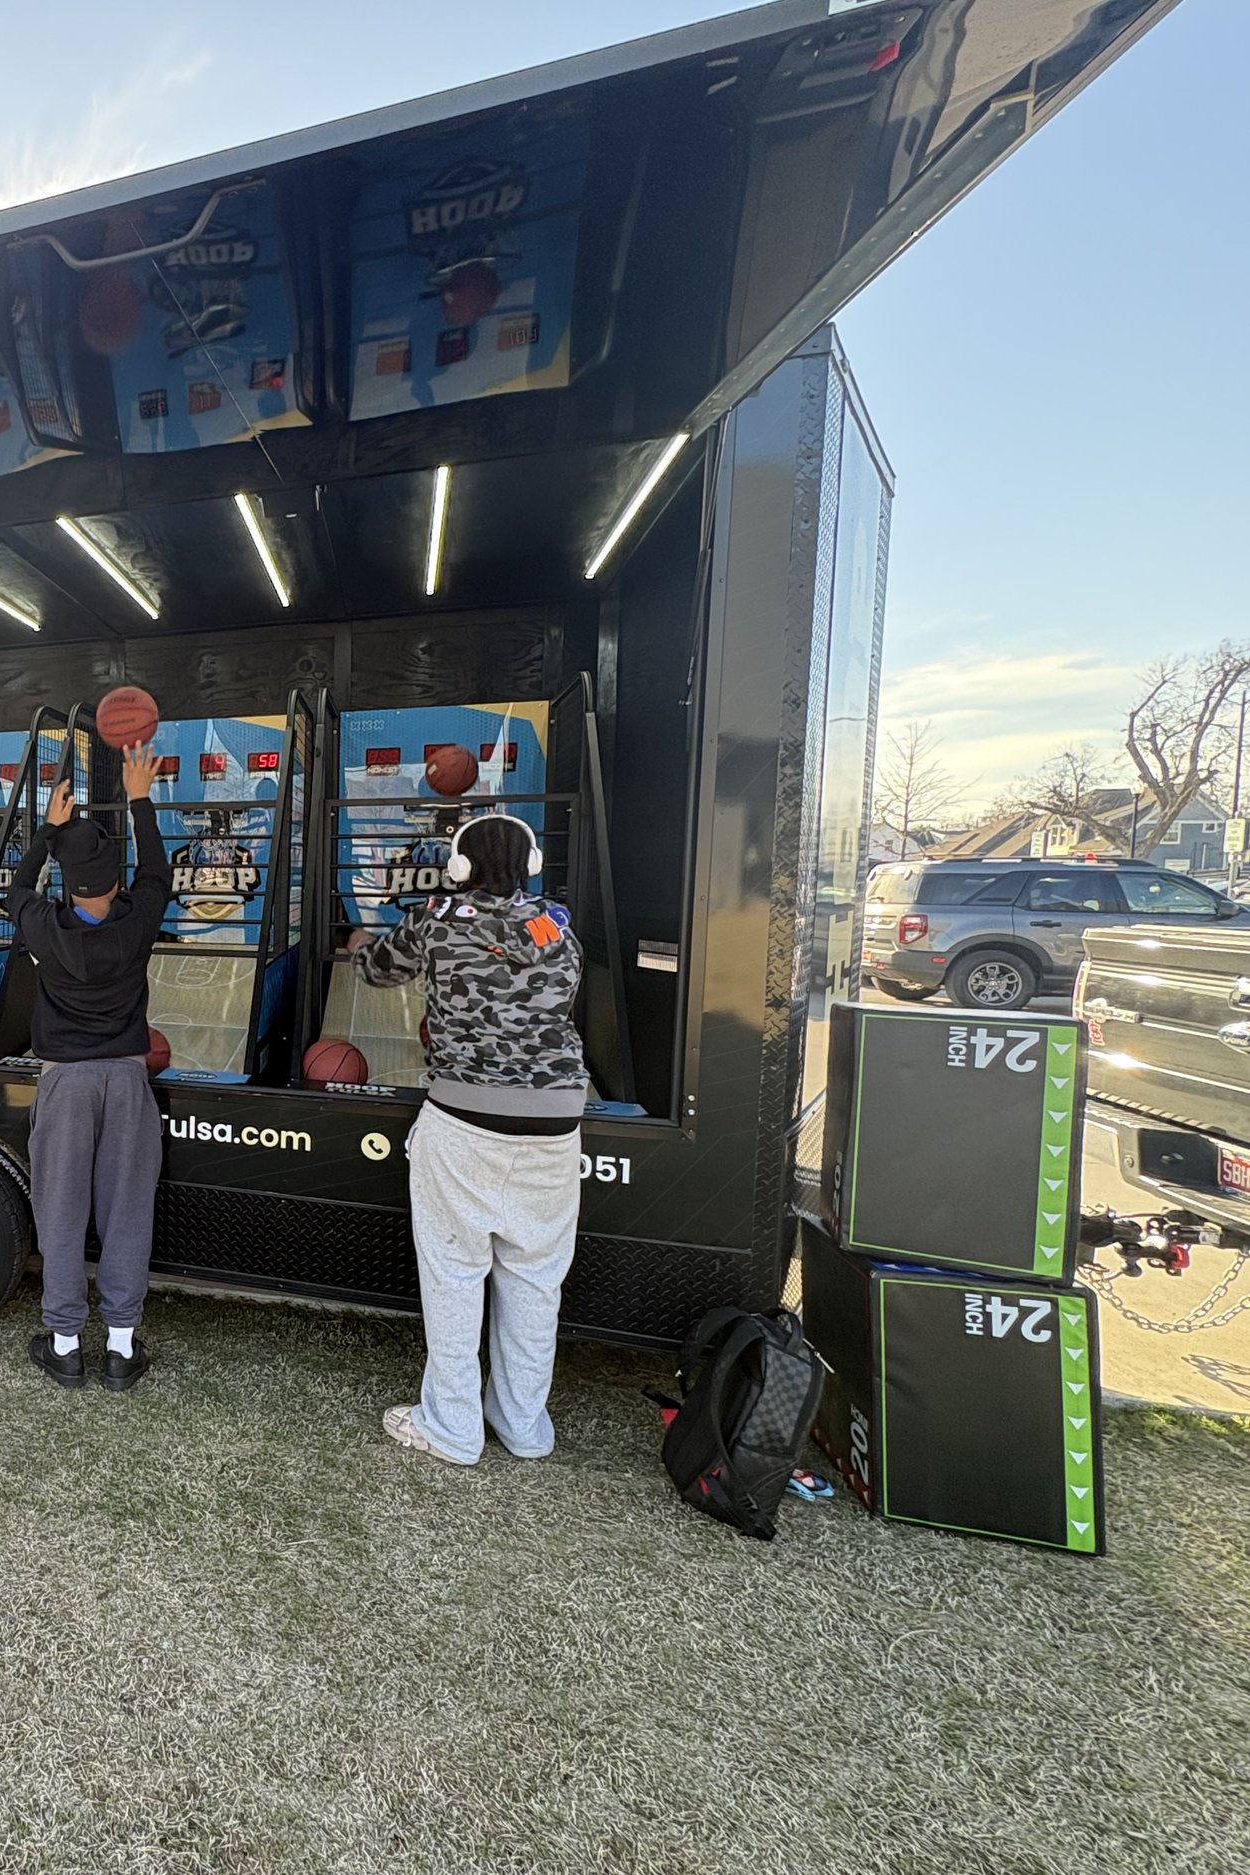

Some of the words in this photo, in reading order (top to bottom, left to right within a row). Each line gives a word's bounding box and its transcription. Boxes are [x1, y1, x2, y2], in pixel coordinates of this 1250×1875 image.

[259, 754, 278, 768] 58
[947, 1026, 968, 1067] INCH
[970, 1028, 1041, 1073] 24
[964, 1293, 984, 1336] INCH
[985, 1296, 1052, 1343] 24
